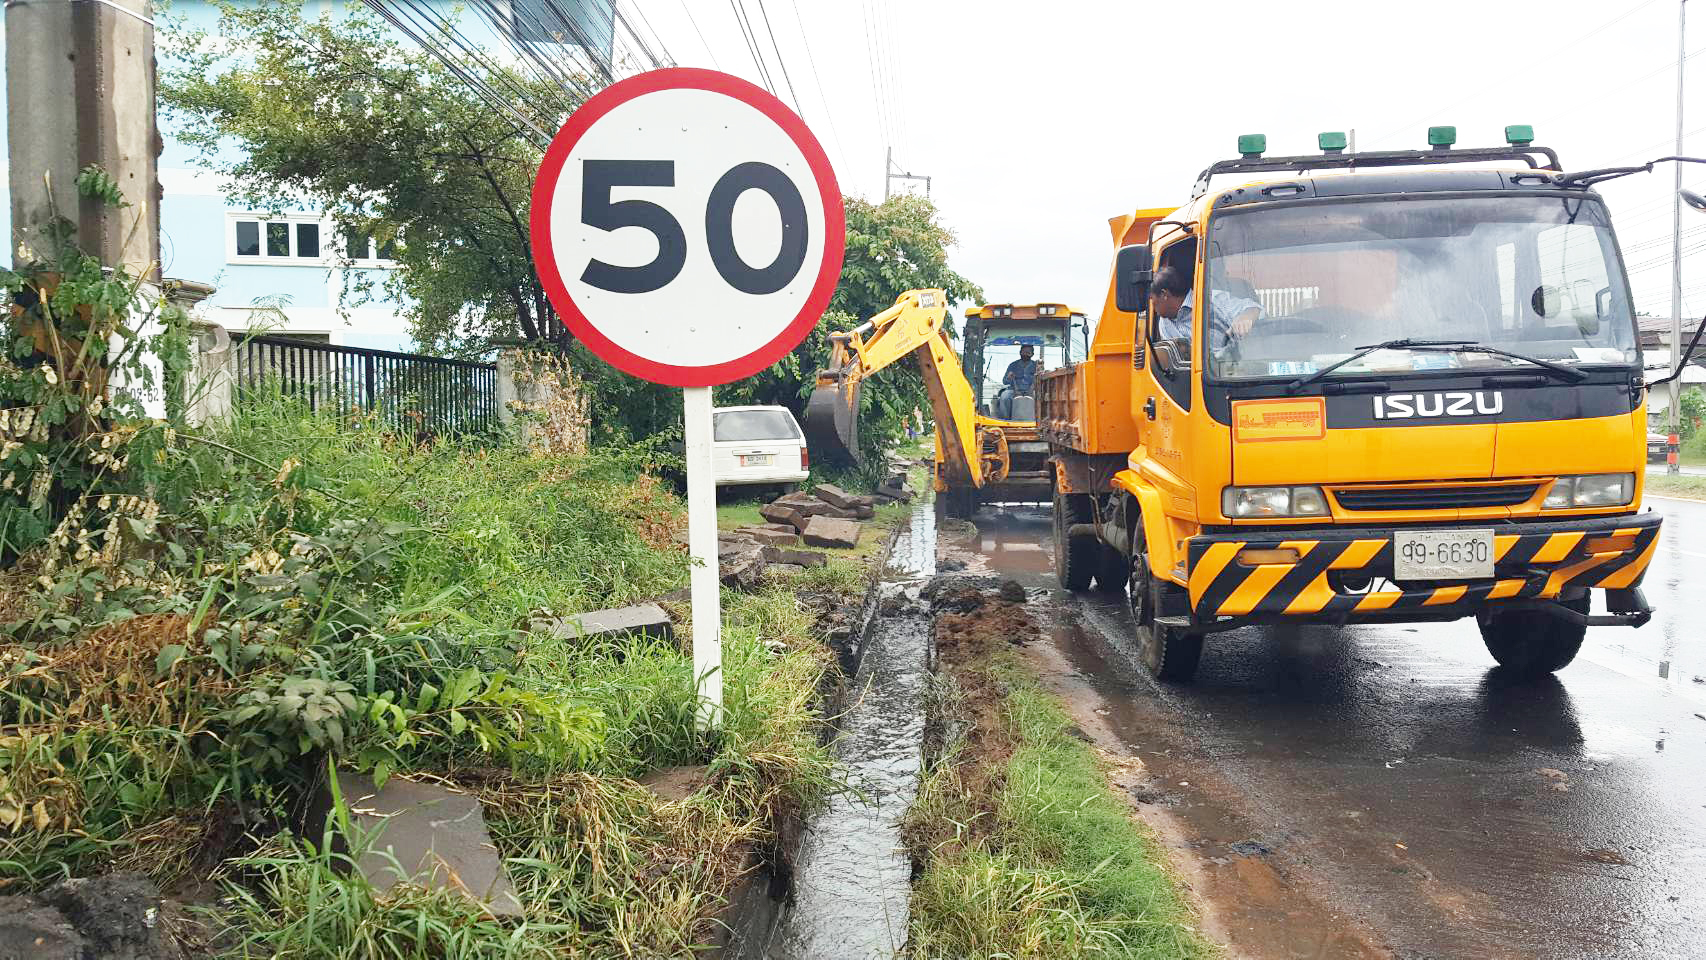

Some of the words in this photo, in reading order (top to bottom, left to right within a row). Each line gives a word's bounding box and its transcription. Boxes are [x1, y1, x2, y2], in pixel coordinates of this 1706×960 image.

[579, 159, 809, 296] 50
[1373, 391, 1503, 419] ISUZU
[1402, 541, 1488, 565] 99-6630
